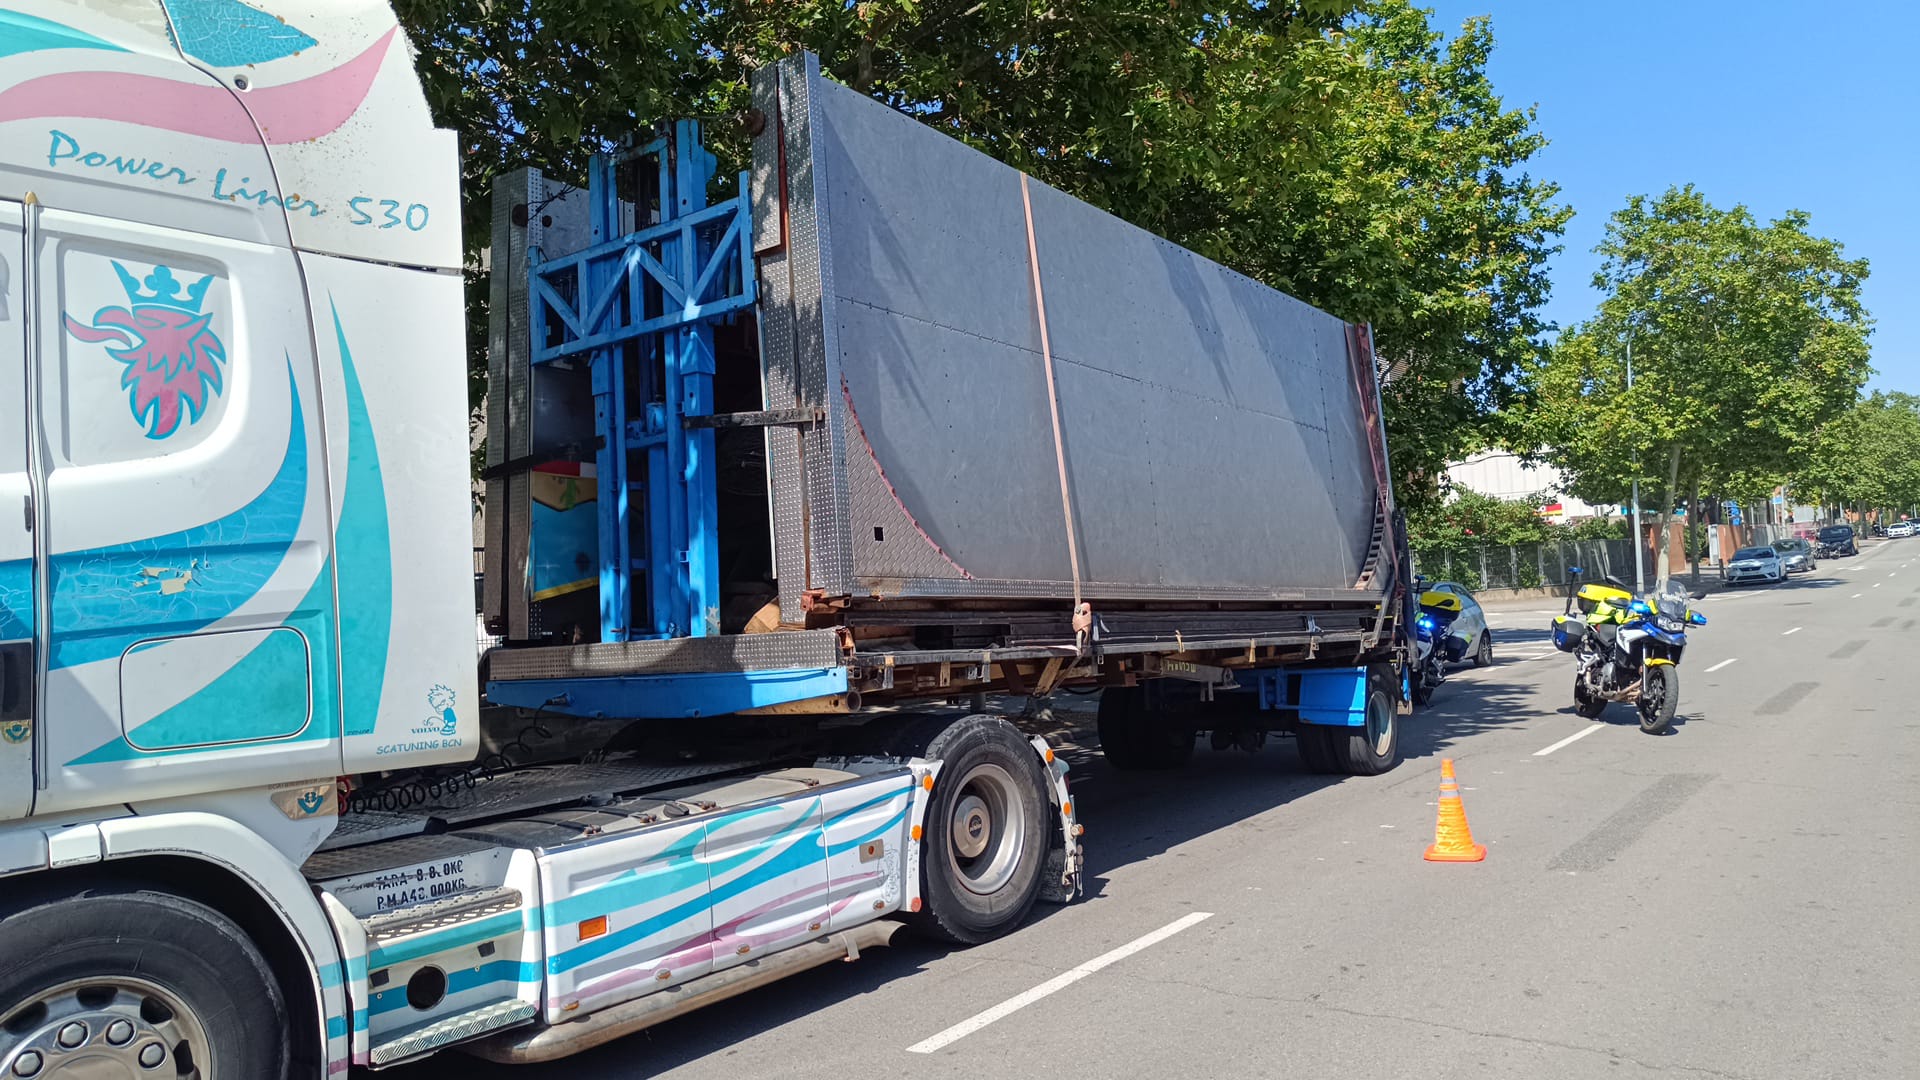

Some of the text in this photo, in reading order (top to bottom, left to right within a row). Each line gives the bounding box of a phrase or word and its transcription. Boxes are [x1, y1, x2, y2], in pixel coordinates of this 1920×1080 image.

[47, 129, 196, 184] Power
[212, 168, 326, 217] Liner
[411, 726, 441, 734] VOLVO
[376, 738, 462, 755] SCATUNING BCN
[376, 872, 408, 890] TARA
